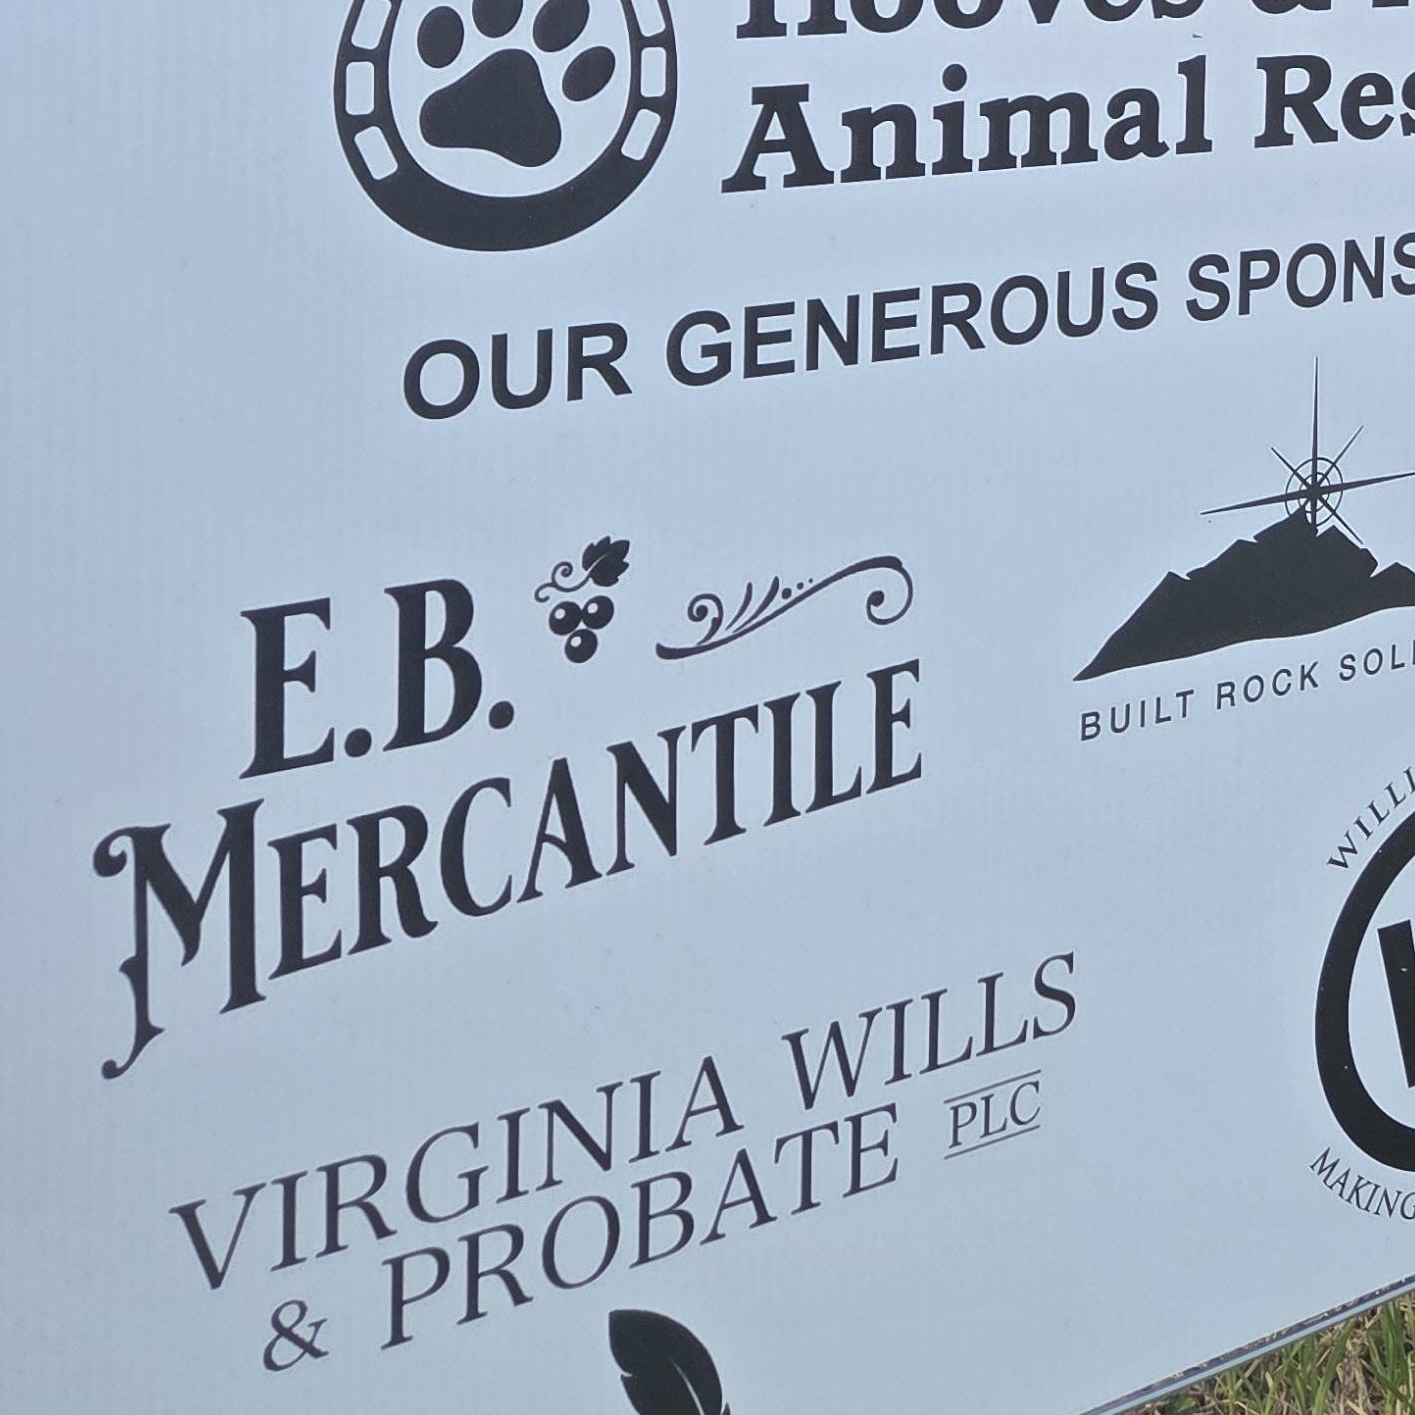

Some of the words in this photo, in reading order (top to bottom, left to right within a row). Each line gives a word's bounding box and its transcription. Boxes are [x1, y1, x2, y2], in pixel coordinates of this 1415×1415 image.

[720, 54, 1213, 194] Animal
[403, 322, 633, 420] OUR
[666, 261, 1159, 387] GENEROUS
[238, 578, 515, 780] E.B.
[1080, 689, 1195, 742] BUILT
[1216, 661, 1319, 710] ROCK
[92, 658, 923, 1080] MERCANTILE
[168, 1055, 745, 1290] VIRGINIA
[781, 951, 1077, 1111] WILLS
[262, 1299, 330, 1372] &
[380, 1102, 899, 1352] PROBATE
[948, 1080, 1042, 1149] PLC
